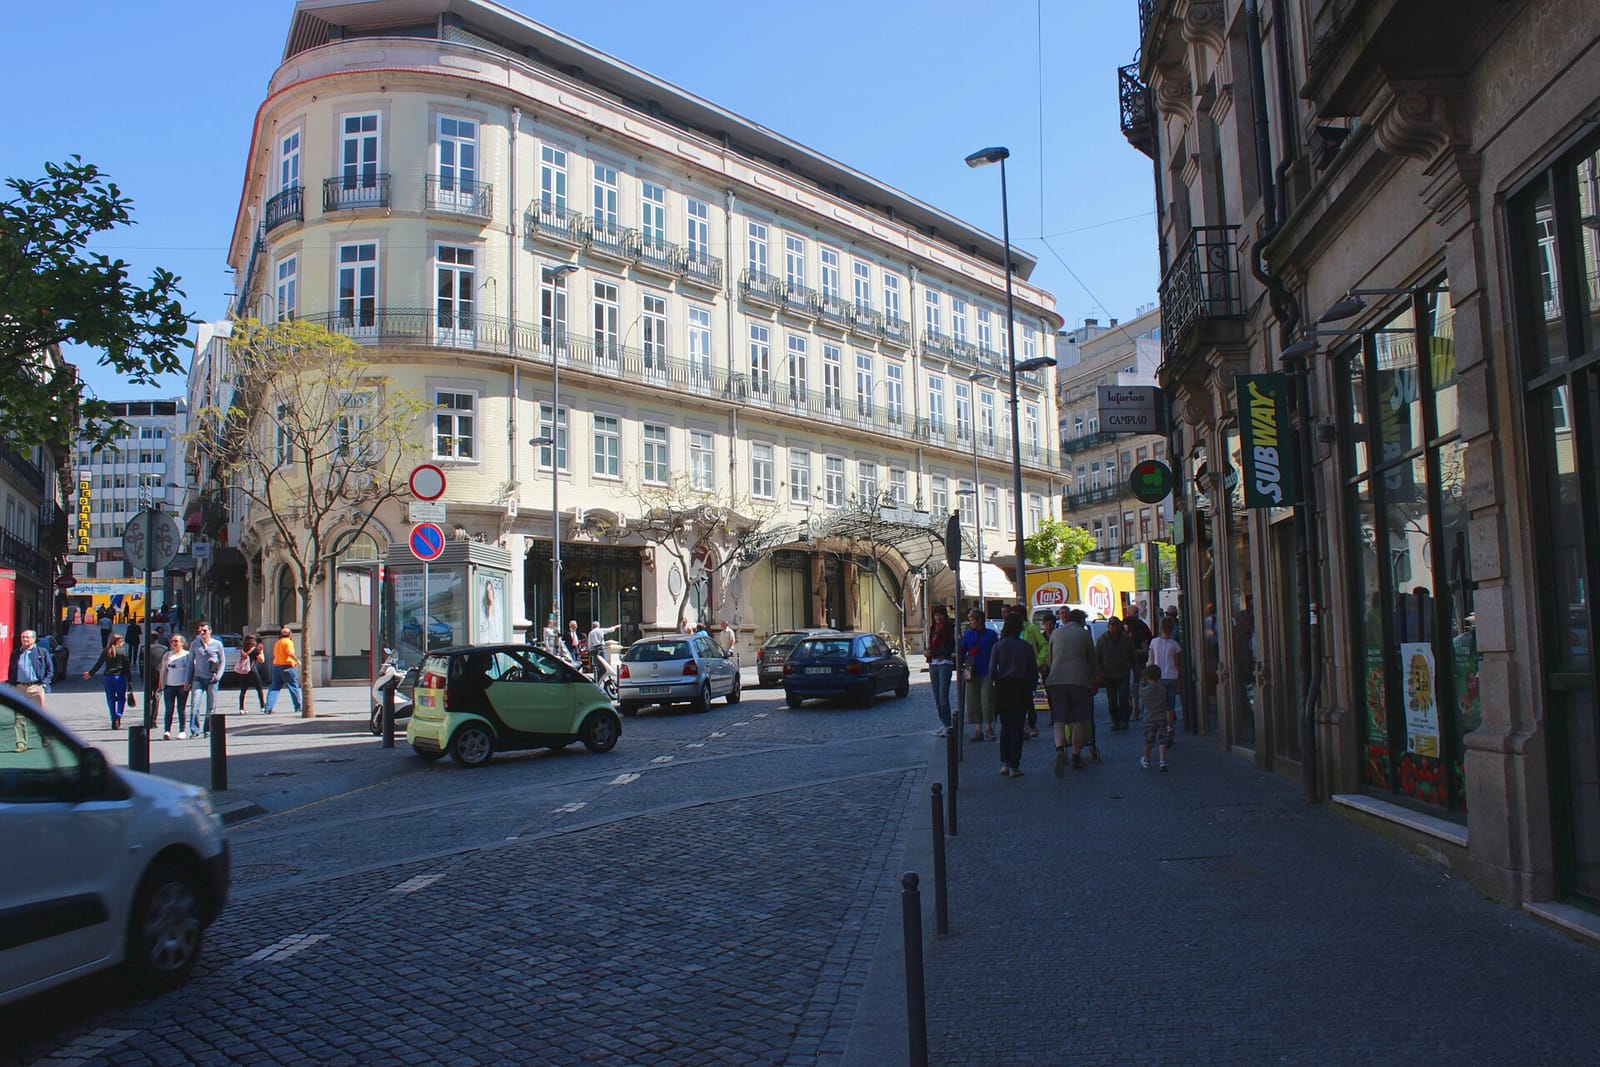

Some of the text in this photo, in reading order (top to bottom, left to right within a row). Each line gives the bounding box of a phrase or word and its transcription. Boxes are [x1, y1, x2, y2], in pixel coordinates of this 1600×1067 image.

[1247, 380, 1284, 504] SUBWAY
[79, 482, 90, 552] REGALEIRA
[479, 577, 504, 591] MGO
[1040, 589, 1061, 604] Lay's
[1092, 587, 1109, 610] Lay's
